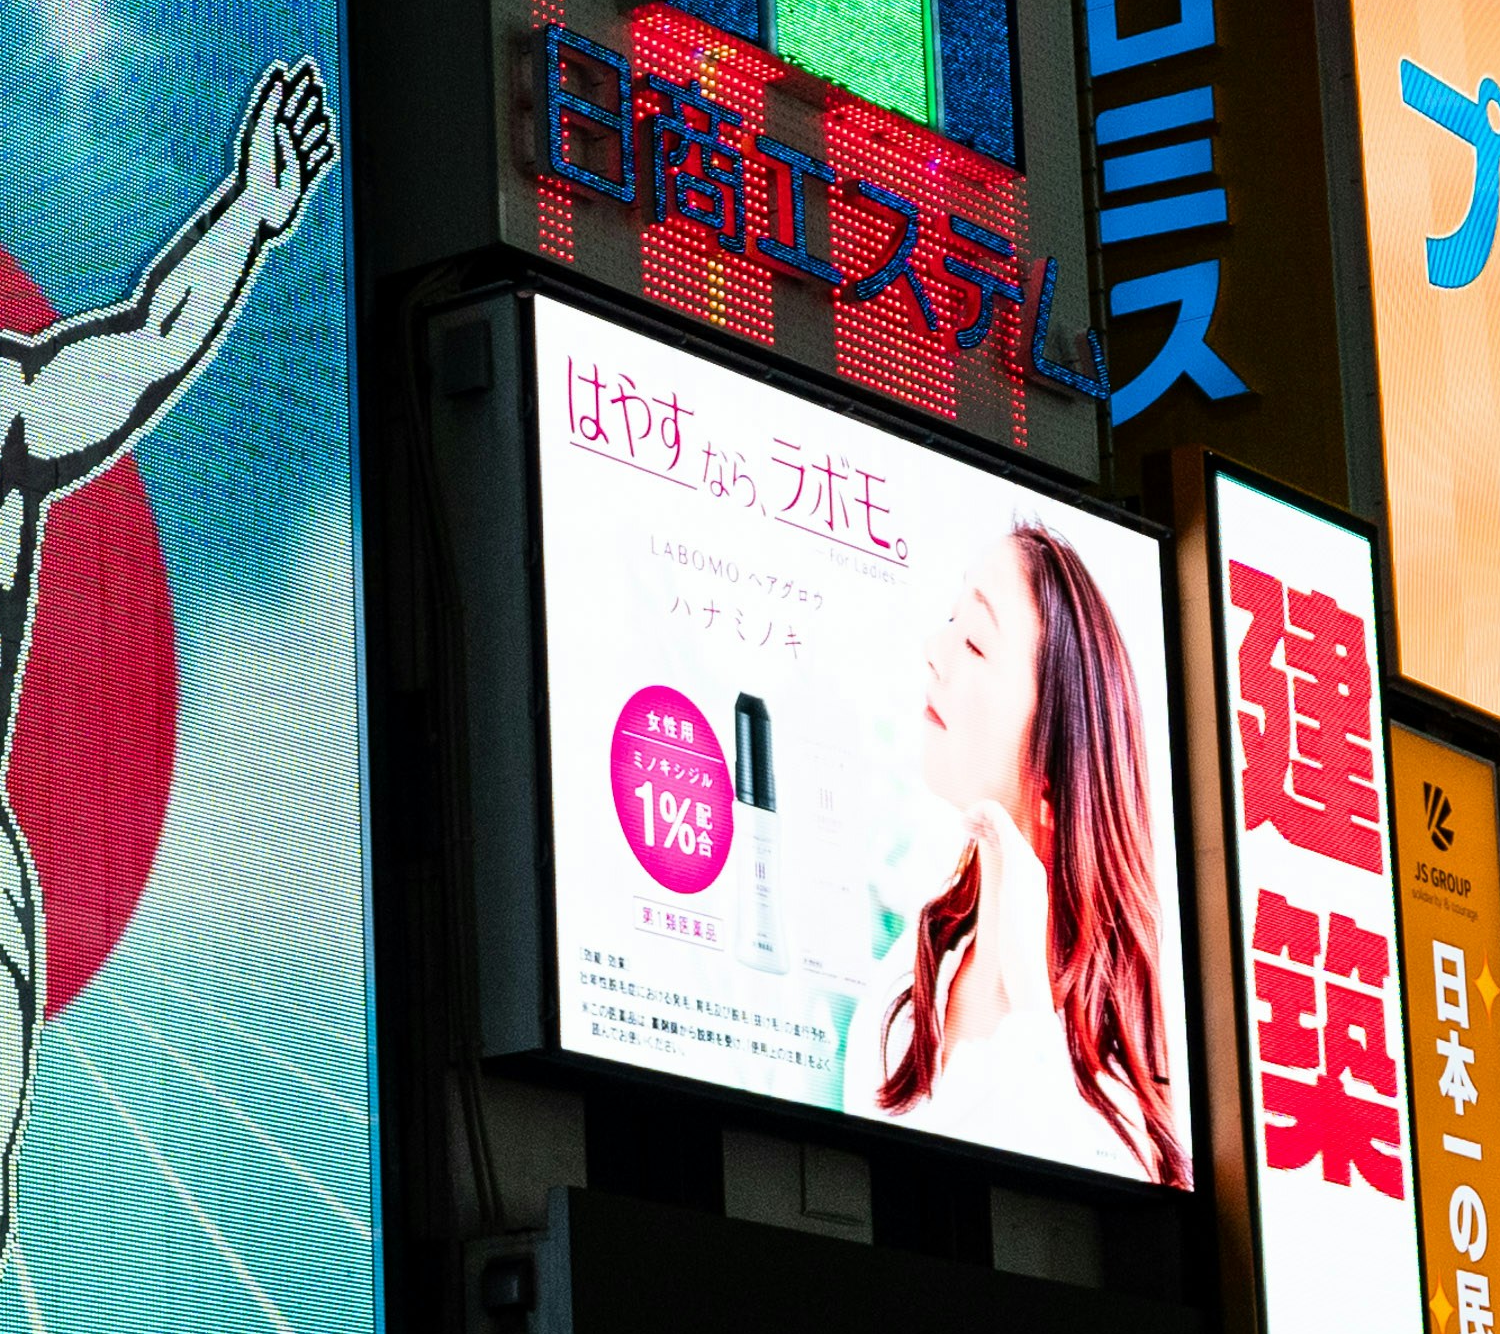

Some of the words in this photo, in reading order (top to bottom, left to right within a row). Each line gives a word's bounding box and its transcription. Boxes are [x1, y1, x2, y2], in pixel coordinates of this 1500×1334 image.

[544, 23, 1112, 401] 日商エステム
[650, 535, 740, 583] LABOMO
[645, 710, 695, 744] 女性用
[633, 750, 714, 789] ミノキシジル
[634, 780, 697, 855] 1%
[695, 801, 714, 858] 配合
[1414, 861, 1429, 884] JS
[1430, 866, 1472, 899] GROUP
